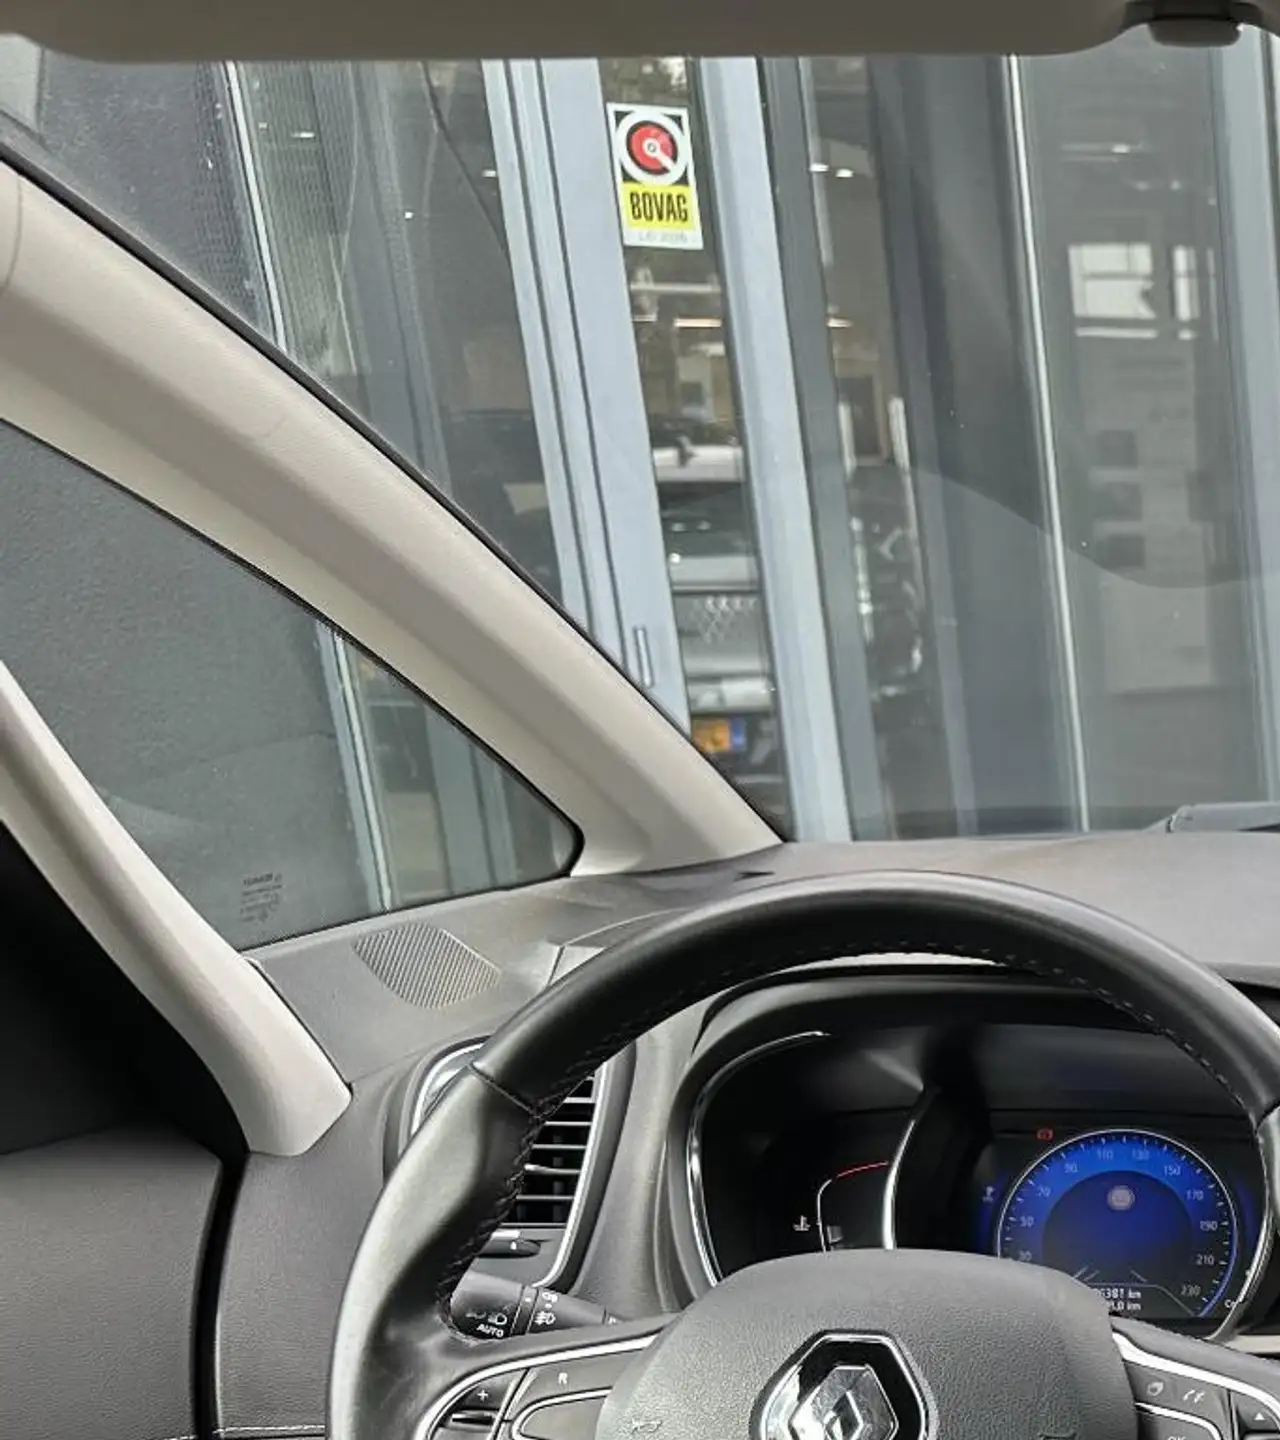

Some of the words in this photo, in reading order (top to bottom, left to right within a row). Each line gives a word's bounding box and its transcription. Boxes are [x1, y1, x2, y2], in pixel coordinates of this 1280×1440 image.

[630, 191, 689, 222] BOVAG
[476, 1323, 505, 1338] AUTO
[558, 1372, 568, 1385] R
